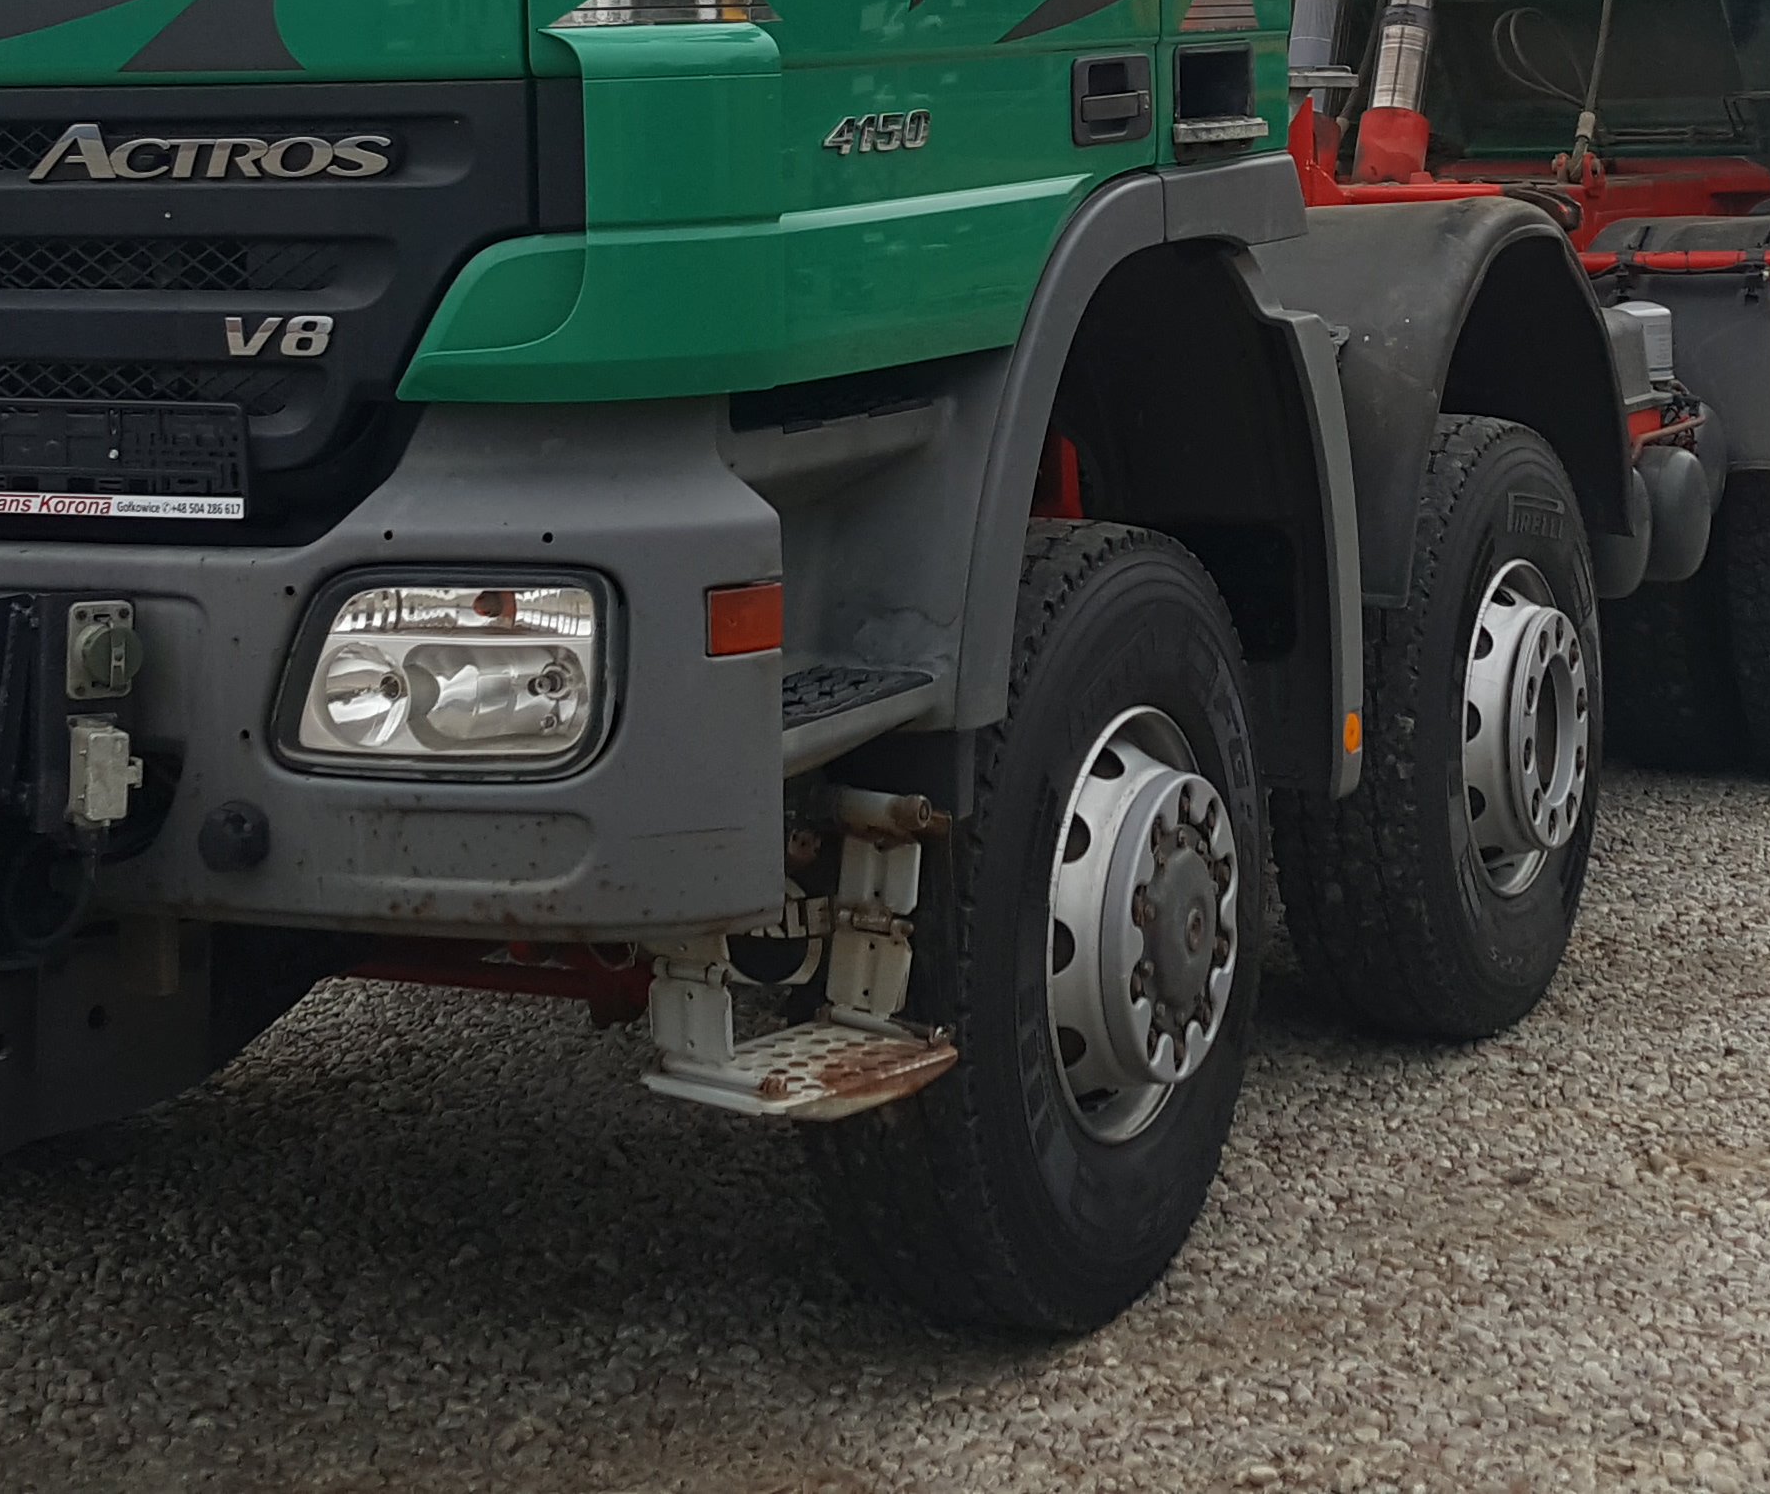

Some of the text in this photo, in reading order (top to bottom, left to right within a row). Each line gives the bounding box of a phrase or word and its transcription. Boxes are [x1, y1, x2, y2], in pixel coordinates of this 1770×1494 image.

[823, 108, 931, 155] 4150
[224, 315, 334, 356] V8
[38, 495, 113, 515] Korona
[189, 502, 204, 514] 504
[207, 503, 223, 514] 286
[225, 504, 241, 515] 617
